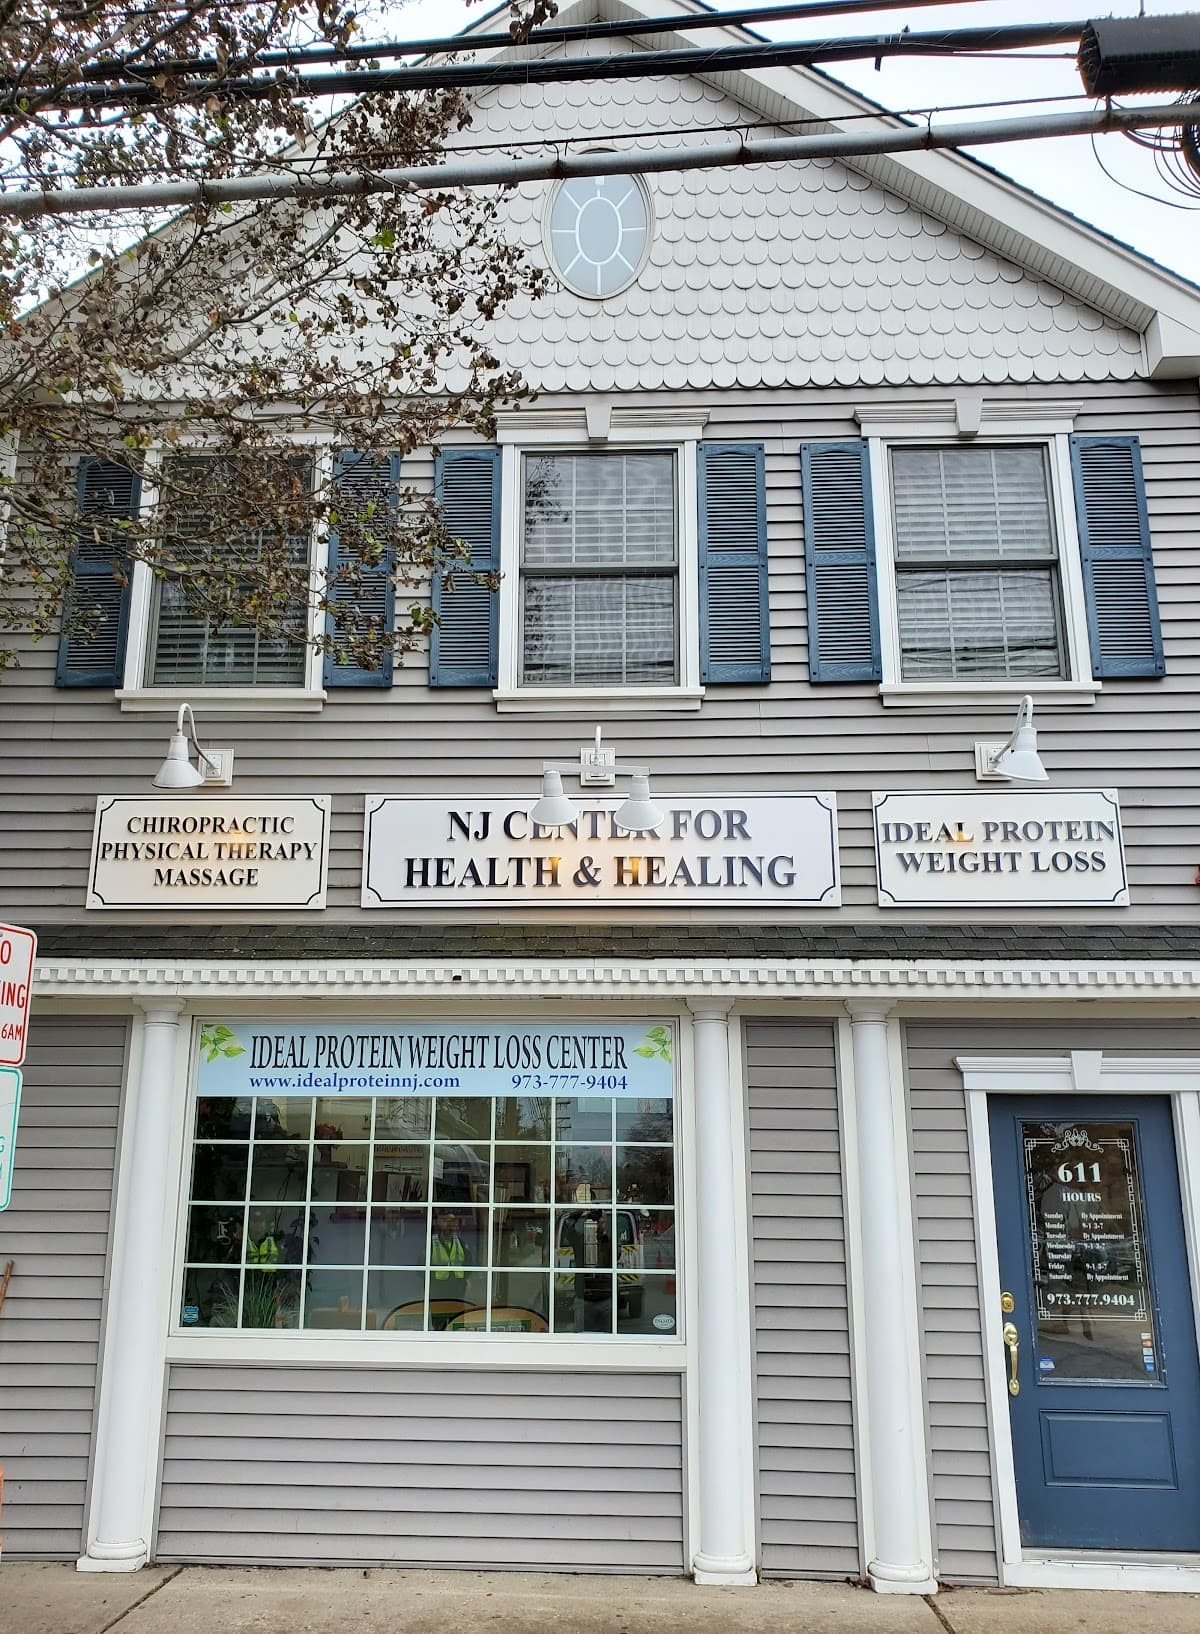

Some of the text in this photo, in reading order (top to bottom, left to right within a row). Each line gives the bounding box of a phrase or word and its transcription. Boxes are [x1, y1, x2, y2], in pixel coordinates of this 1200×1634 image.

[127, 816, 295, 835] CHIROPRACTIC
[447, 811, 490, 841] NJ
[670, 809, 752, 841] FOR
[881, 820, 1117, 843] IDEAL PROTEIN
[101, 842, 318, 861] PHYSICAL THERAPY
[404, 855, 797, 888] HEALTH & HEALING
[896, 851, 1107, 873] WEIGHT LOSS
[154, 868, 259, 888] MASSAGE
[250, 1034, 628, 1070] IDEAL PROTEIN WEIGHT LOSS CENTER
[250, 1072, 460, 1091] www.idealproteinnj.com
[512, 1074, 628, 1090] 973-777-9404
[1058, 1162, 1102, 1183] 611
[1063, 1192, 1101, 1202] HOURS
[1044, 1212, 1063, 1220] Sunday
[1045, 1222, 1065, 1230] Monday
[1046, 1232, 1066, 1241] Tuesday
[1048, 1253, 1072, 1261] Thursday
[1048, 1263, 1065, 1271] Friday
[1049, 1273, 1072, 1282] Saturday
[1047, 1294, 1135, 1306] 973.777.9404
